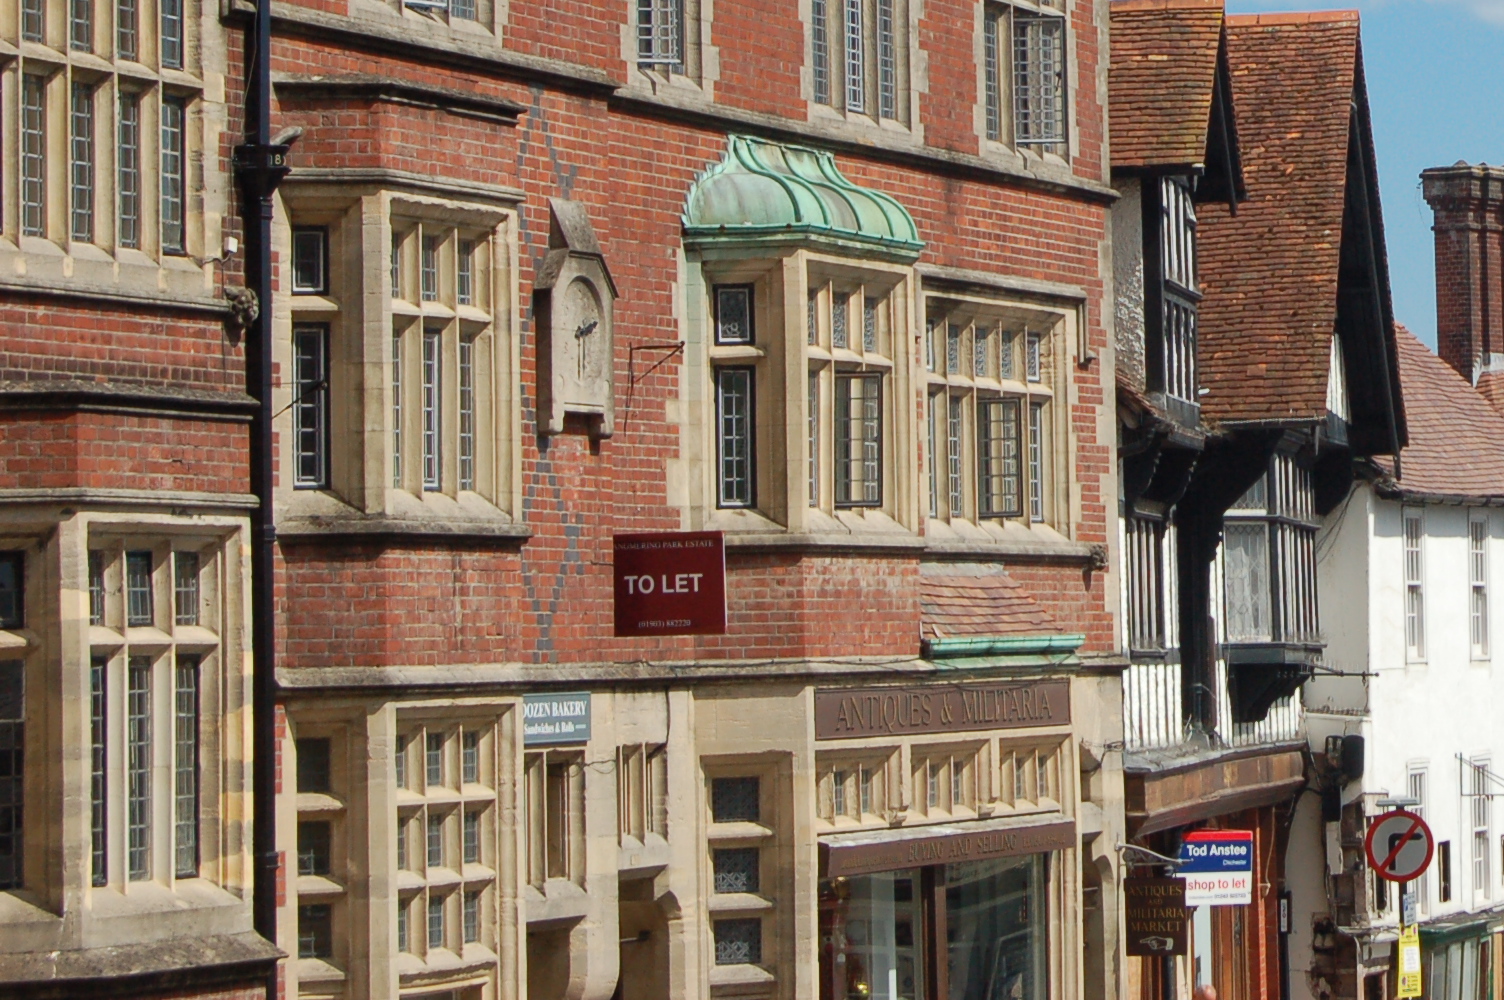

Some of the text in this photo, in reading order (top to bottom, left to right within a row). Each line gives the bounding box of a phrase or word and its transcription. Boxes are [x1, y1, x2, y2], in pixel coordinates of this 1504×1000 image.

[662, 540, 683, 548] PARK
[685, 539, 714, 548] ESTATE
[623, 573, 703, 595] TO LET
[552, 700, 587, 717] BAKERY
[835, 688, 1052, 733] ANTIQUES & MILITARIA
[907, 843, 944, 863] BUYING
[949, 838, 971, 860] AND
[976, 833, 1017, 855] SELLING
[1187, 844, 1248, 857] Tod Anstee
[1128, 884, 1183, 896] ANTIQUES
[1187, 877, 1246, 892] shop to let
[1128, 907, 1185, 919] MILITARIA
[1130, 921, 1180, 932] MARKET
